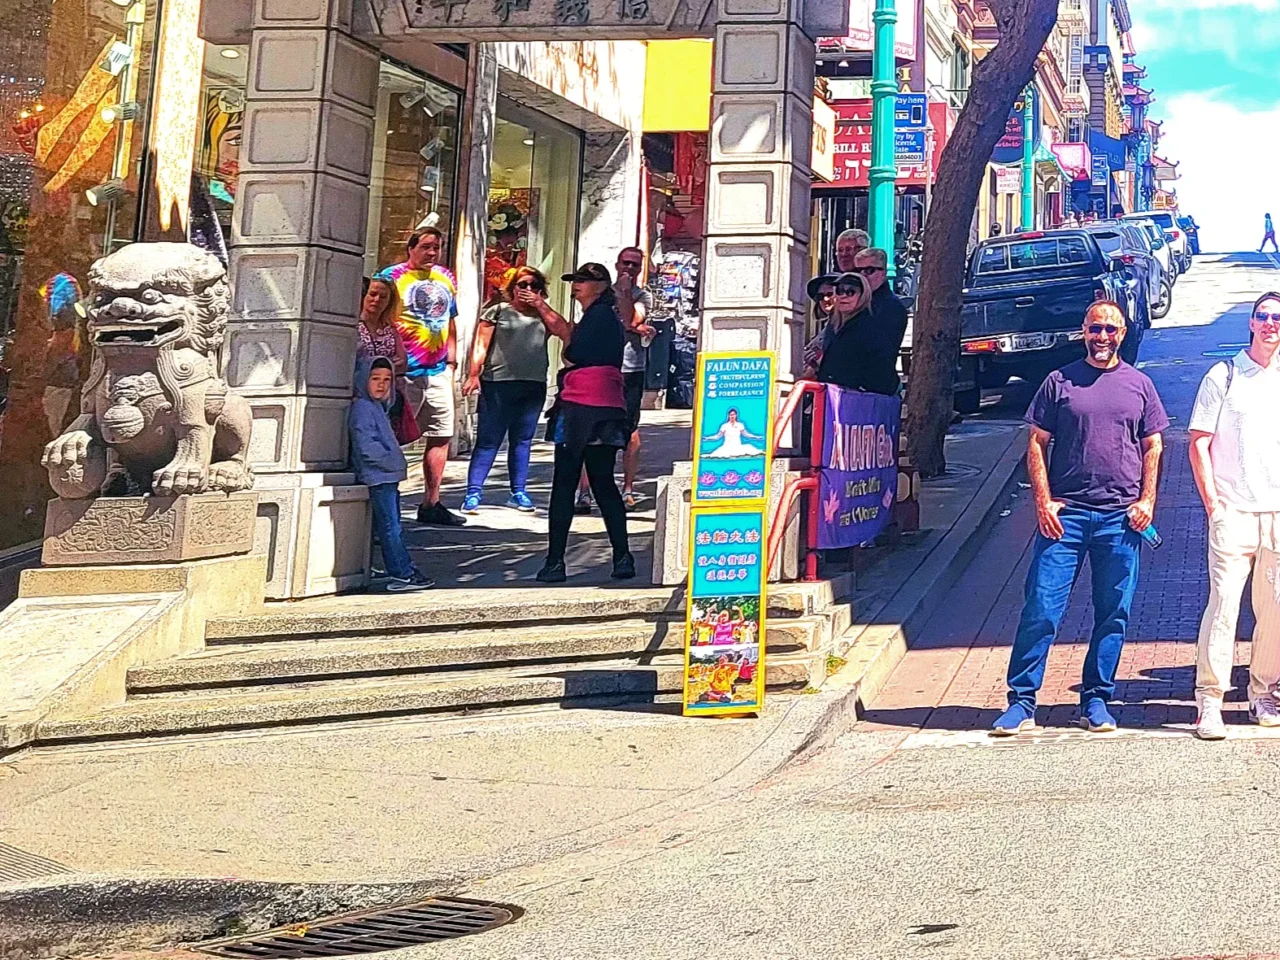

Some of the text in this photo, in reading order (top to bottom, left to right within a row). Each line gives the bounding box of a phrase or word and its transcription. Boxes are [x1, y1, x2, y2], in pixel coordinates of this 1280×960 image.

[908, 96, 925, 104] here
[706, 360, 768, 372] FALUN DAFA
[719, 381, 764, 389] COMPASSION
